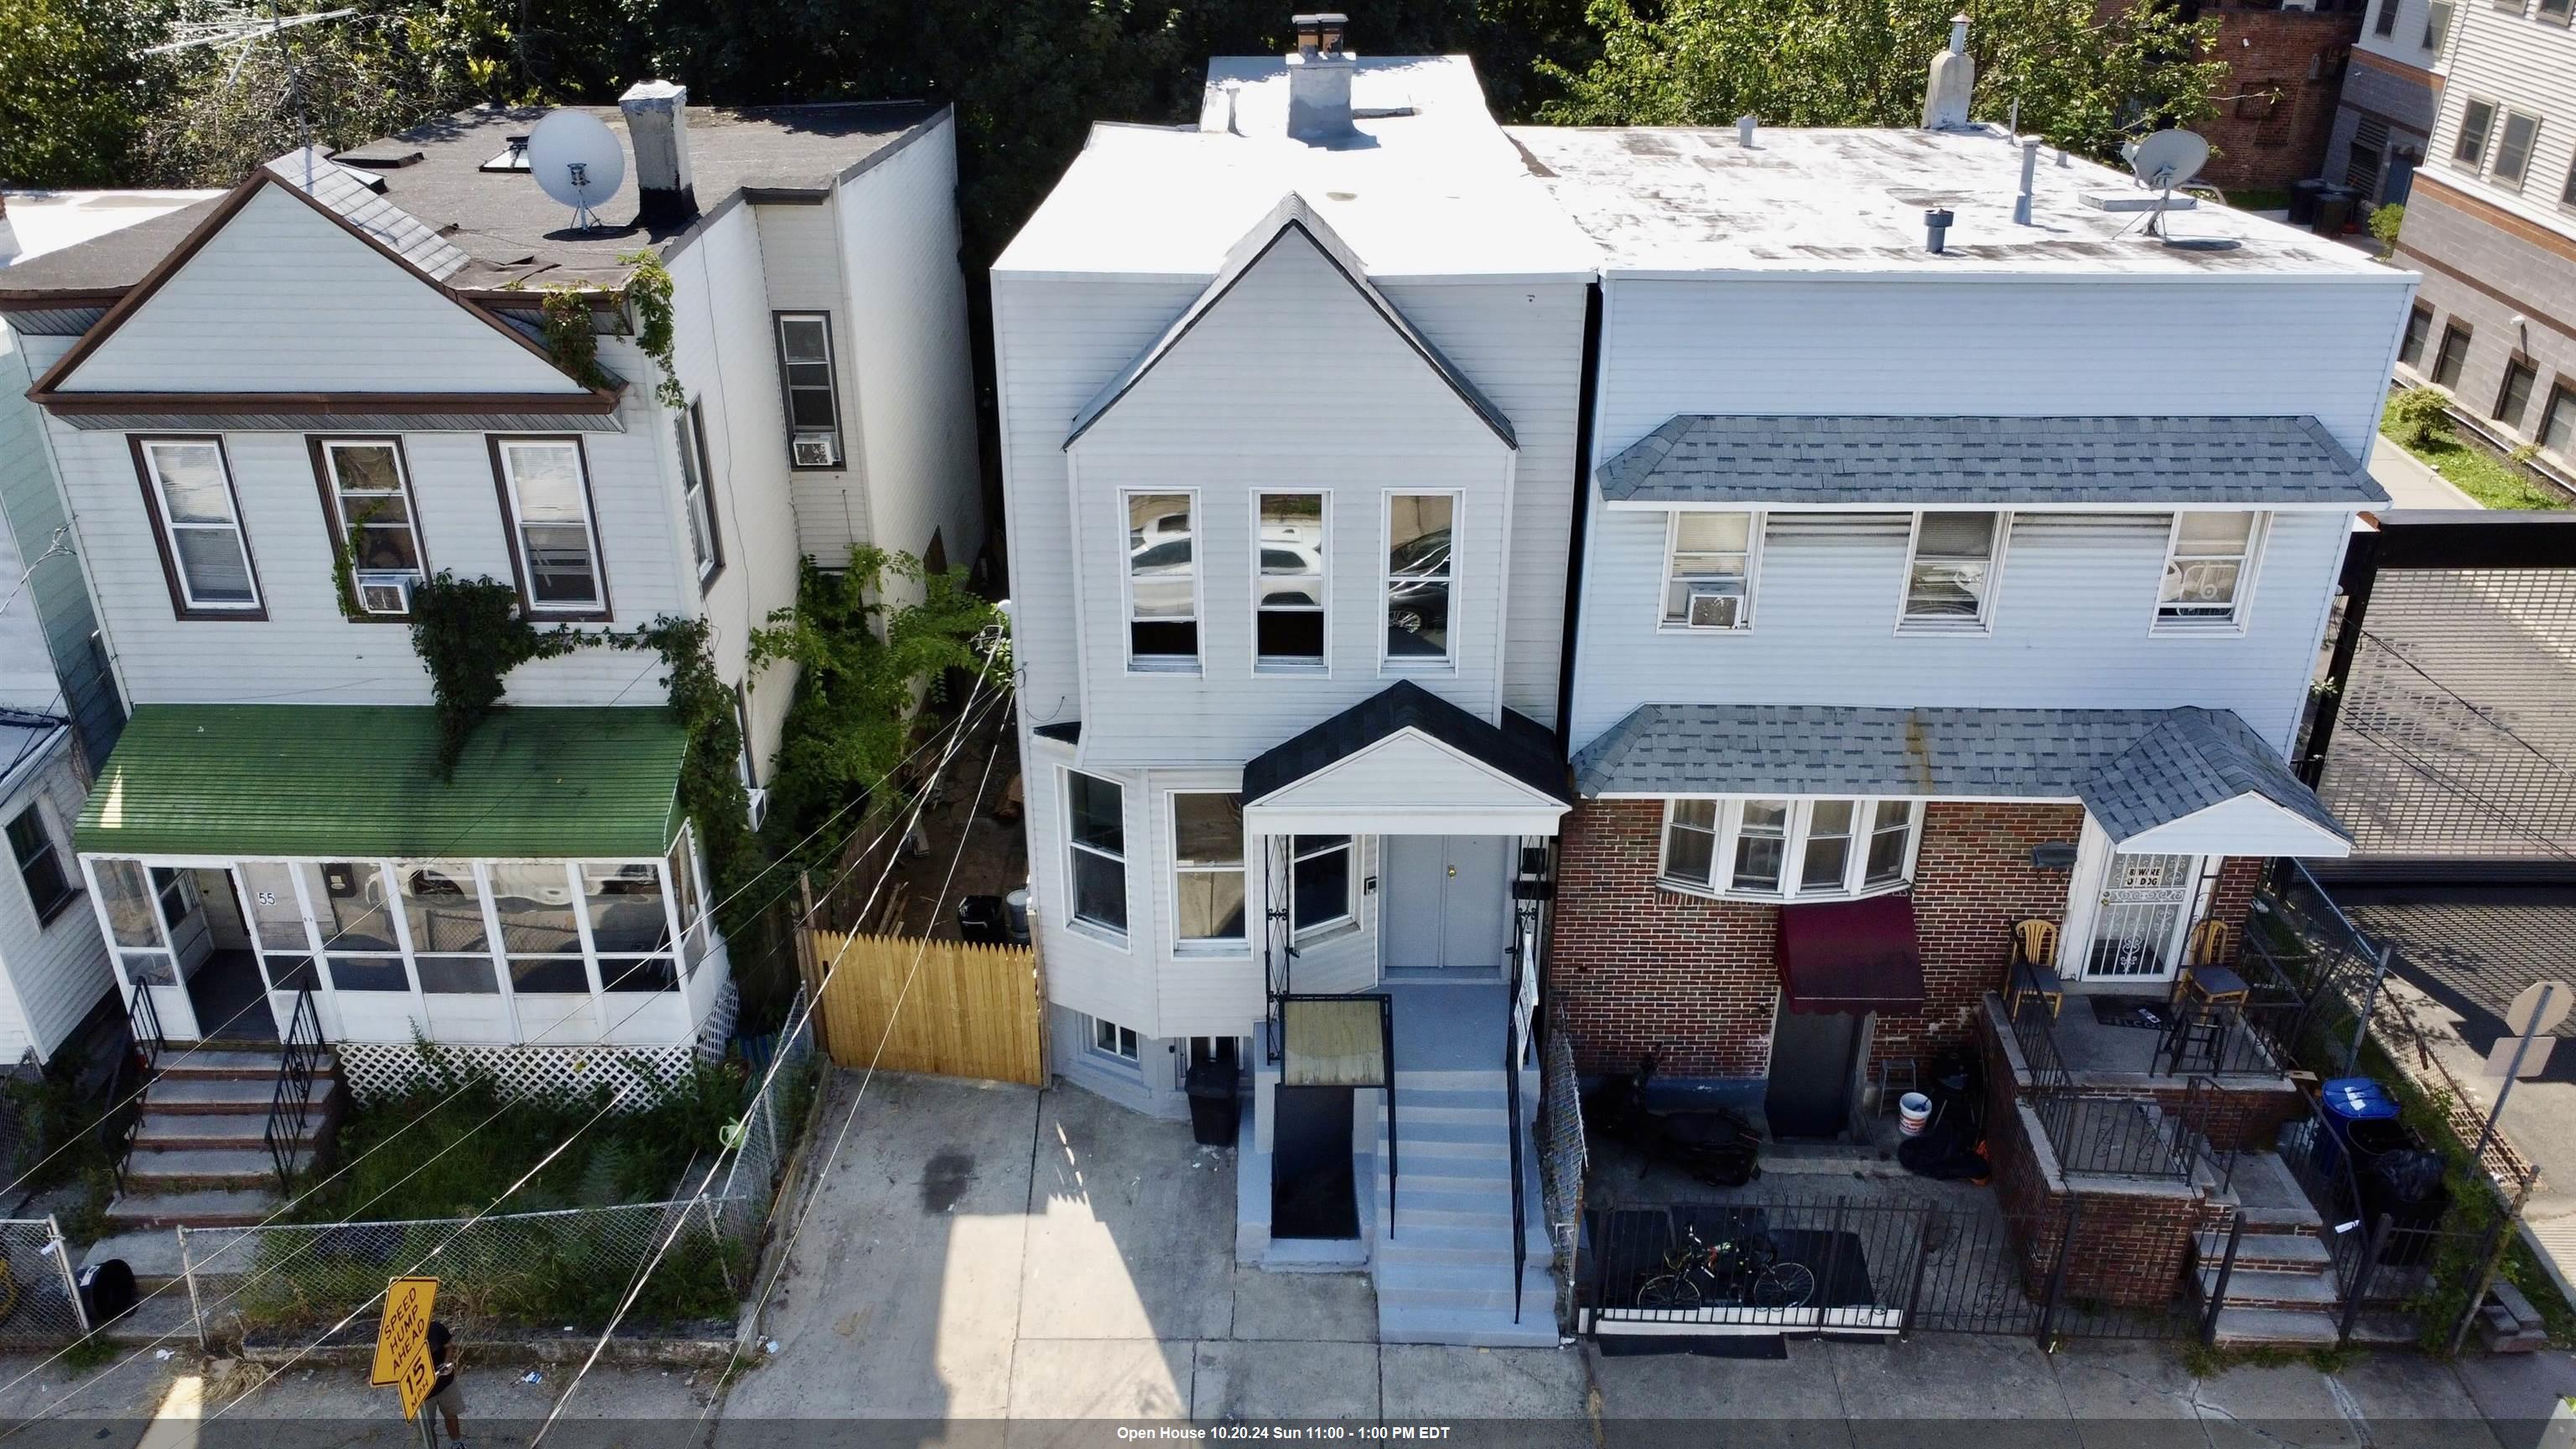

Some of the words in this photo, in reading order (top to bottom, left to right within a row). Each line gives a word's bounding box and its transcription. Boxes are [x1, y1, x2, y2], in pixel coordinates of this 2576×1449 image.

[259, 892, 275, 905] 55
[384, 1287, 417, 1340] SPEED
[390, 1304, 418, 1354] HUMP
[392, 1318, 425, 1375] AHEAD
[406, 1355, 425, 1395] 15
[411, 1379, 429, 1410] MPH
